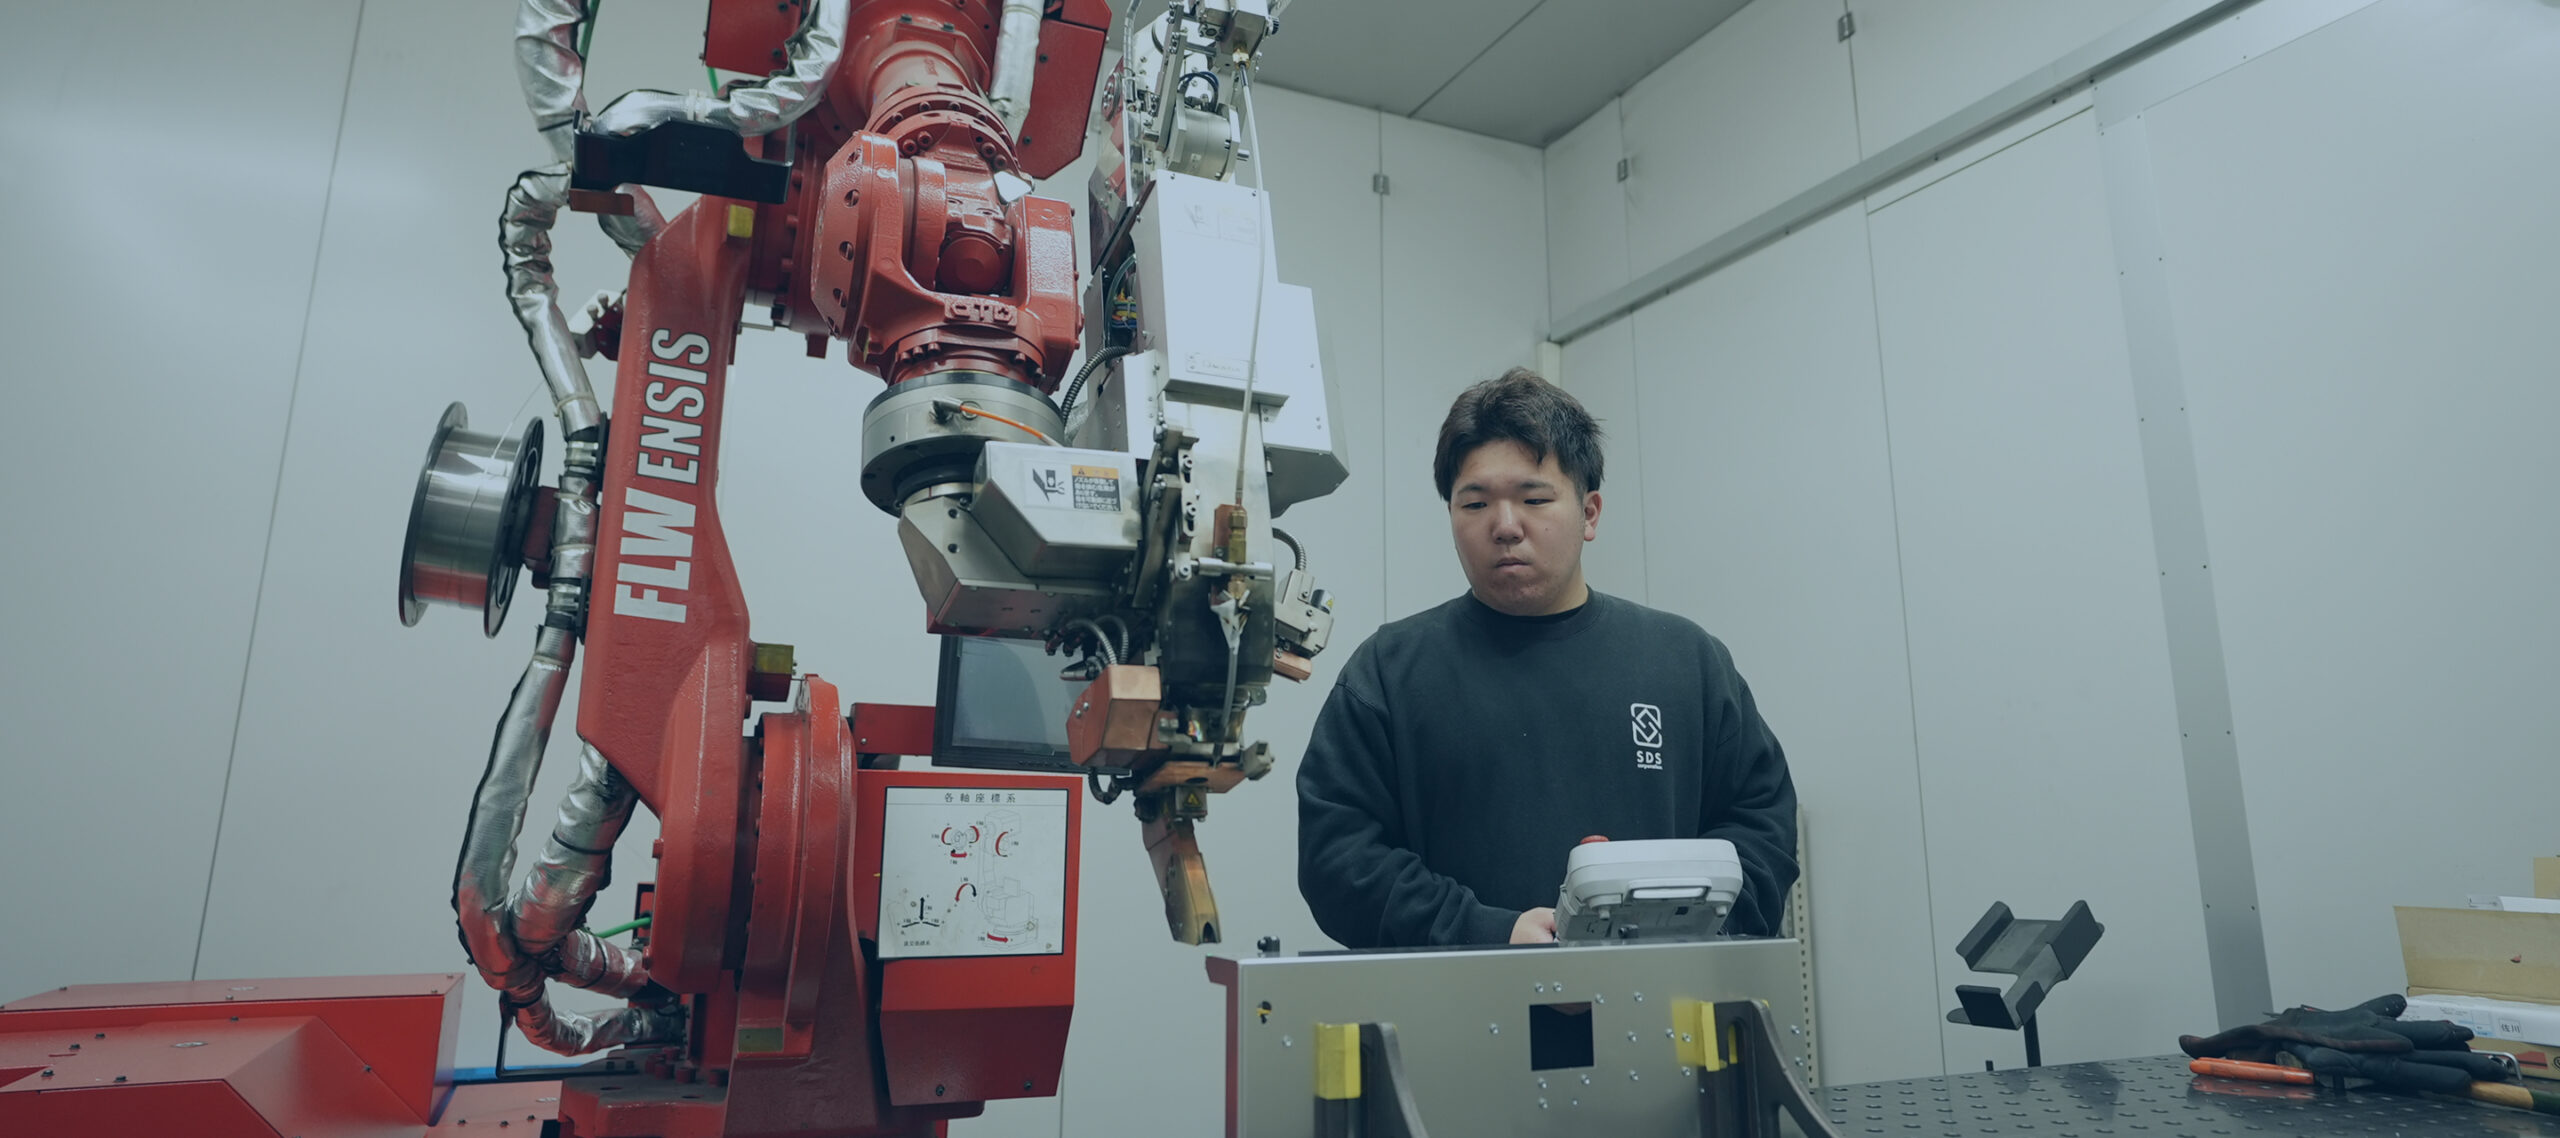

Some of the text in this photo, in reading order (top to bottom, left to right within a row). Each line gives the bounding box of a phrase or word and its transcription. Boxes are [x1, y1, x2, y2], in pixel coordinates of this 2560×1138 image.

[614, 328, 711, 623] FLW ENSIS
[1636, 750, 1662, 765] SDS
